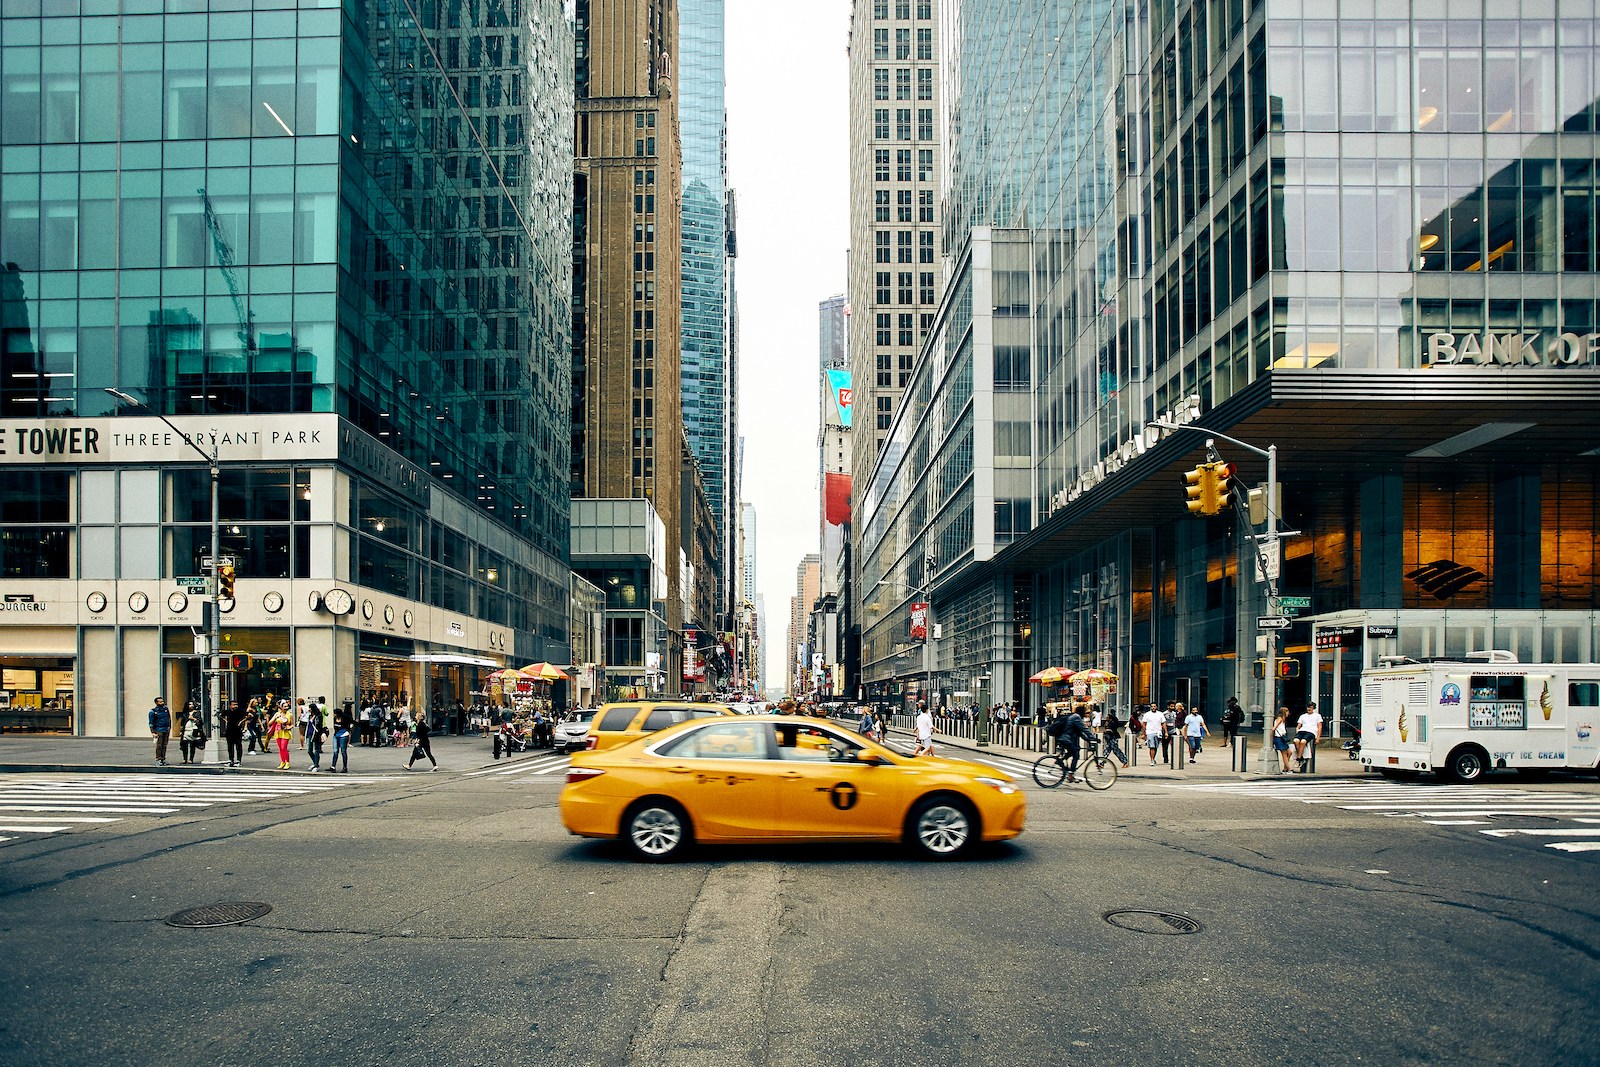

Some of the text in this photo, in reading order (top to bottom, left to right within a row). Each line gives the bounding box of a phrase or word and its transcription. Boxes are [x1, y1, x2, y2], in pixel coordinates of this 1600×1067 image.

[1428, 332, 1541, 366] BANK
[15, 427, 99, 455] TOWER
[113, 430, 321, 446] THREE BRYANT PARK
[1368, 626, 1394, 634] Subway
[1520, 751, 1533, 760] ICE
